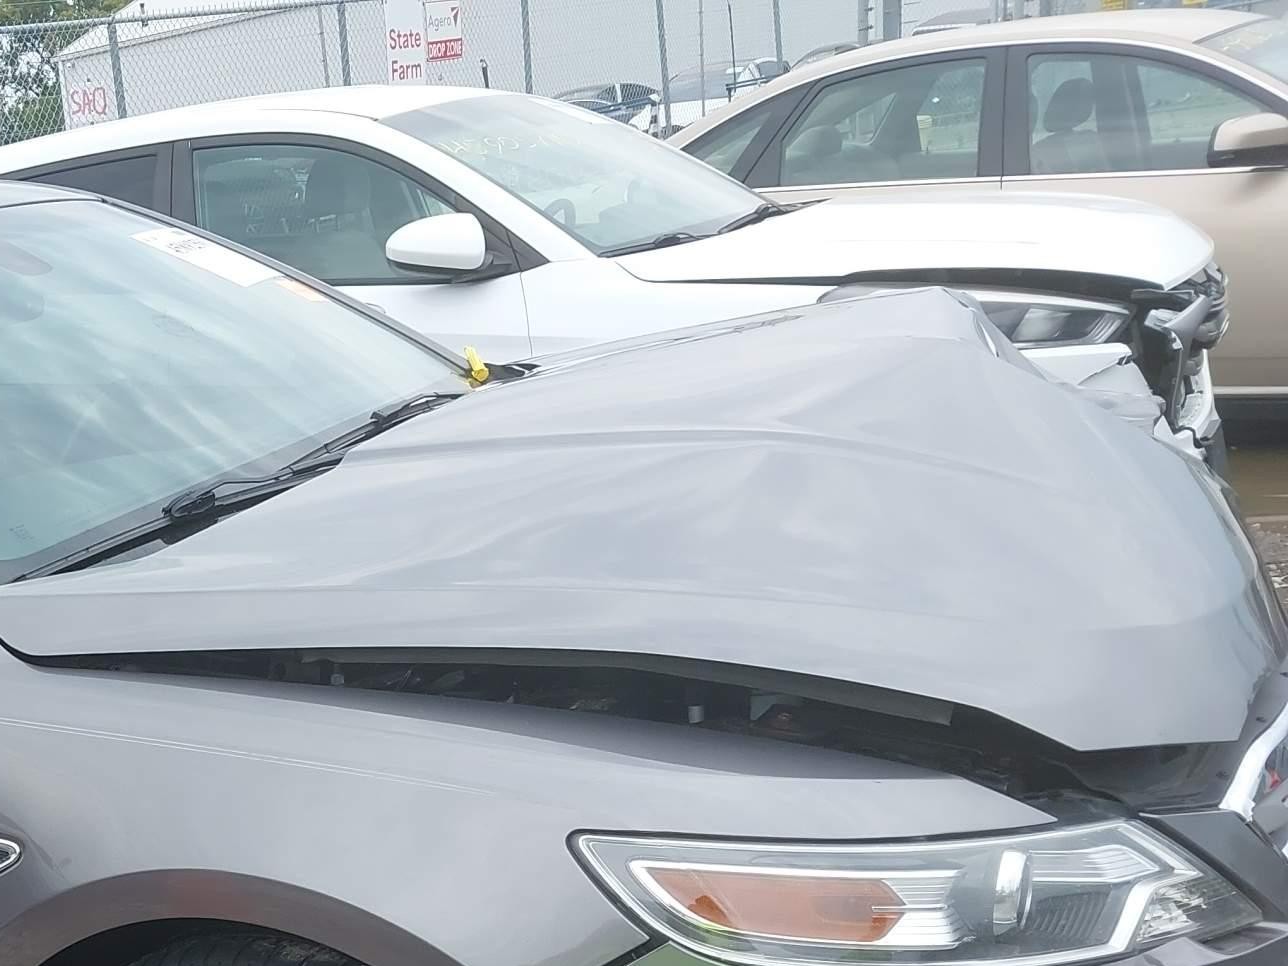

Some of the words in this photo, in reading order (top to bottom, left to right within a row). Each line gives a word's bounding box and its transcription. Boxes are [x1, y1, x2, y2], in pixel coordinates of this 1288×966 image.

[389, 28, 422, 50] State
[428, 43, 445, 57] DROP
[446, 41, 462, 56] ZONE
[391, 60, 422, 81] Farm
